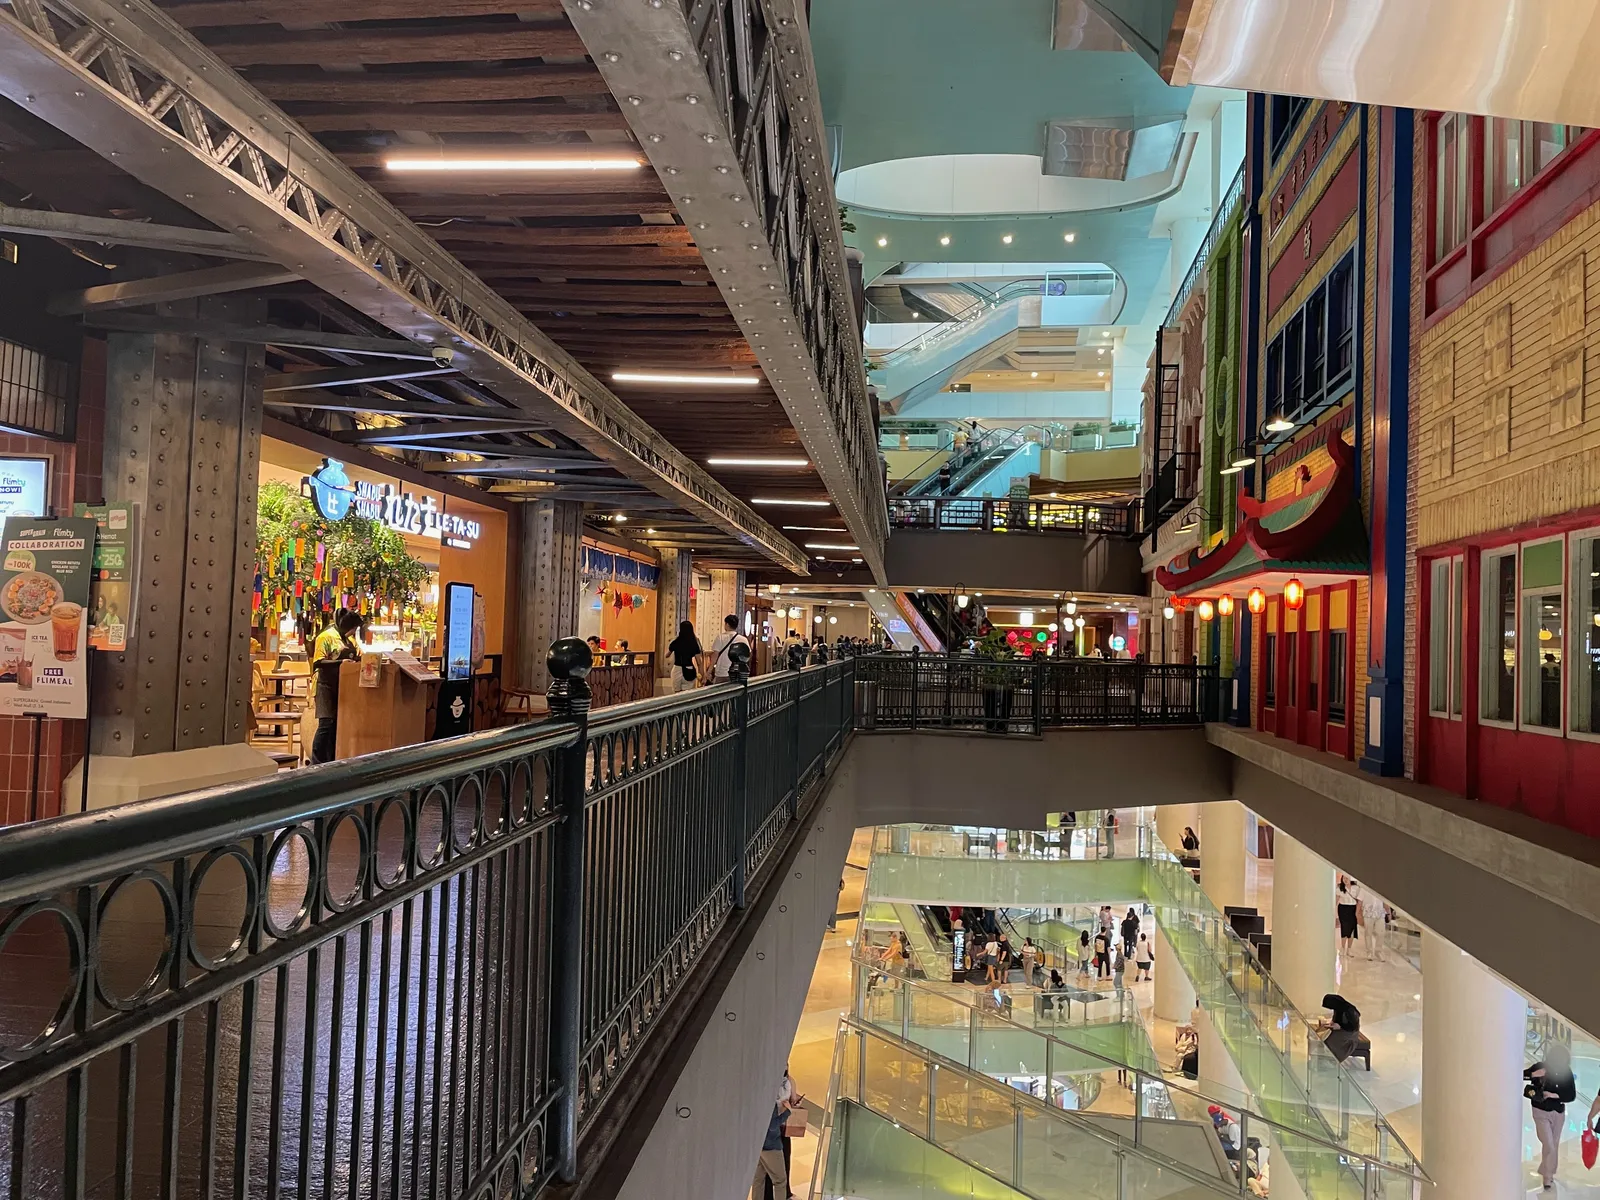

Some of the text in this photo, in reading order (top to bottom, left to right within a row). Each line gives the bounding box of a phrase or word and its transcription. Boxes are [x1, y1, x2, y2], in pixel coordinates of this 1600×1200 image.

[357, 480, 381, 502] SHABU
[355, 500, 381, 520] SHABU
[9, 540, 83, 549] COLLABORATION
[36, 677, 73, 685] FLIMEAL
